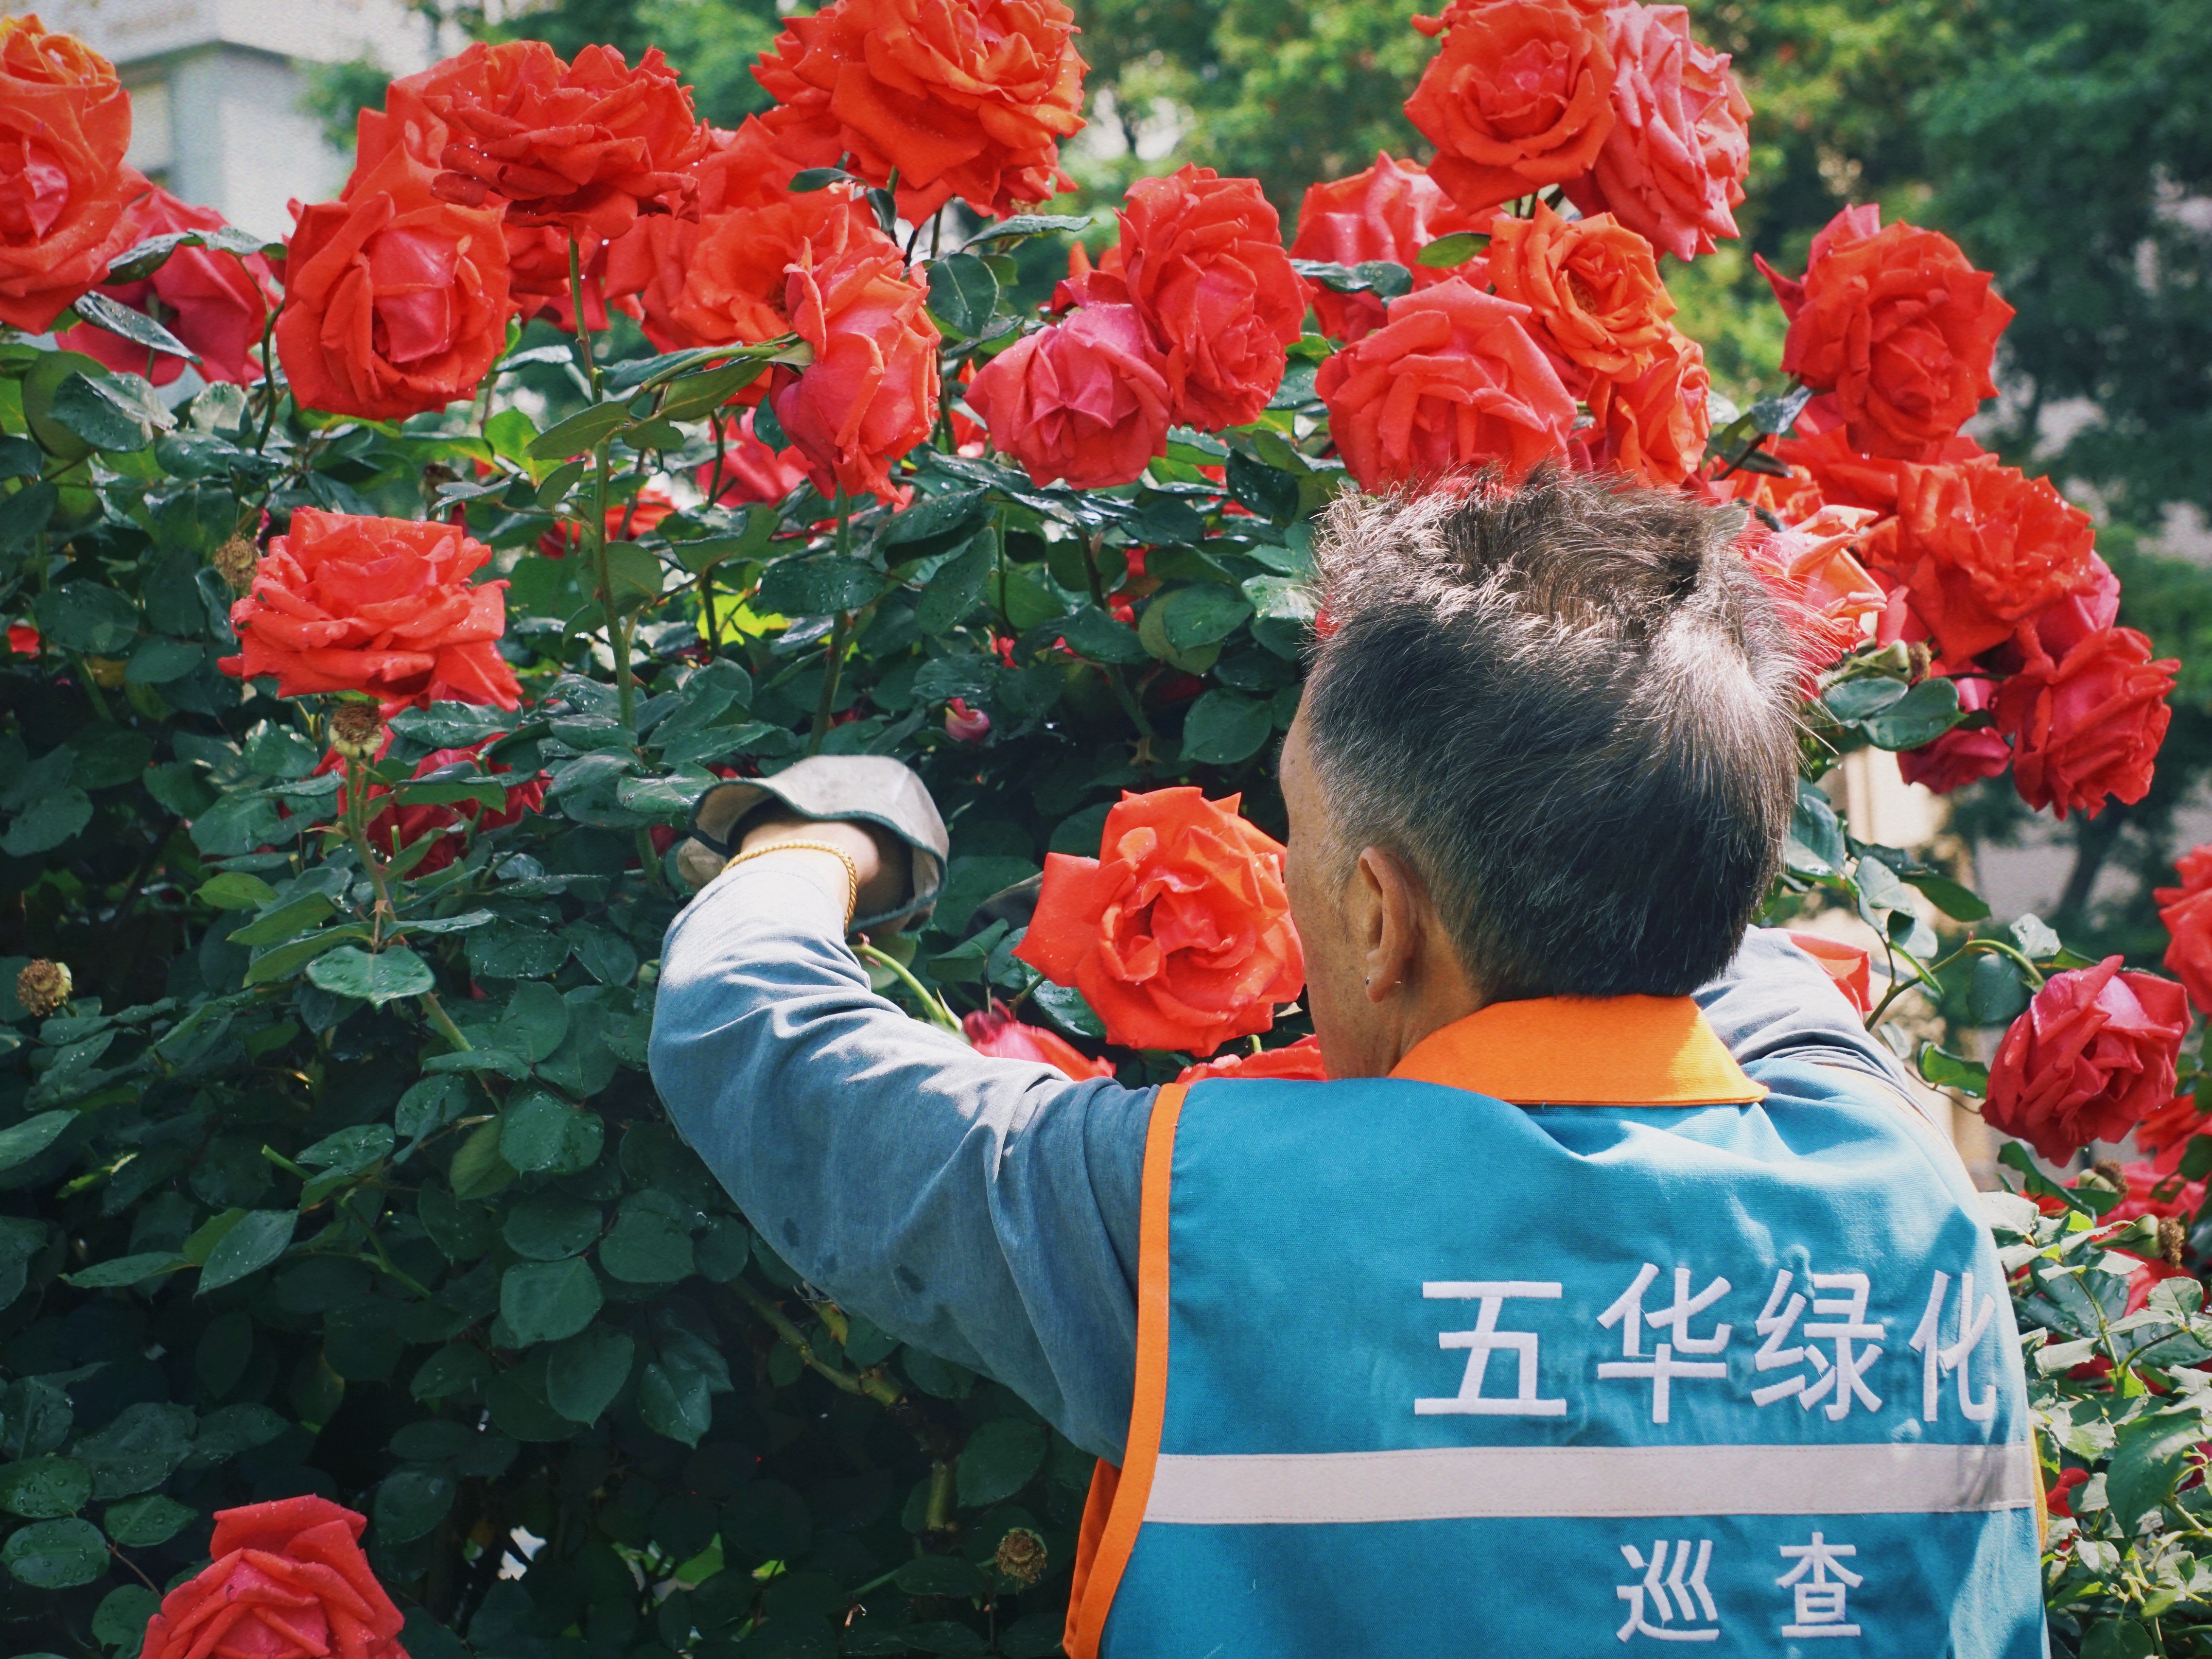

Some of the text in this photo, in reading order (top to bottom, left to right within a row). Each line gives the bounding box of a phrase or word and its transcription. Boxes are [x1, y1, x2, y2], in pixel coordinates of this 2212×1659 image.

[1414, 1262, 1996, 1423] 五华绿化
[1616, 1531, 1864, 1643] 巡查
